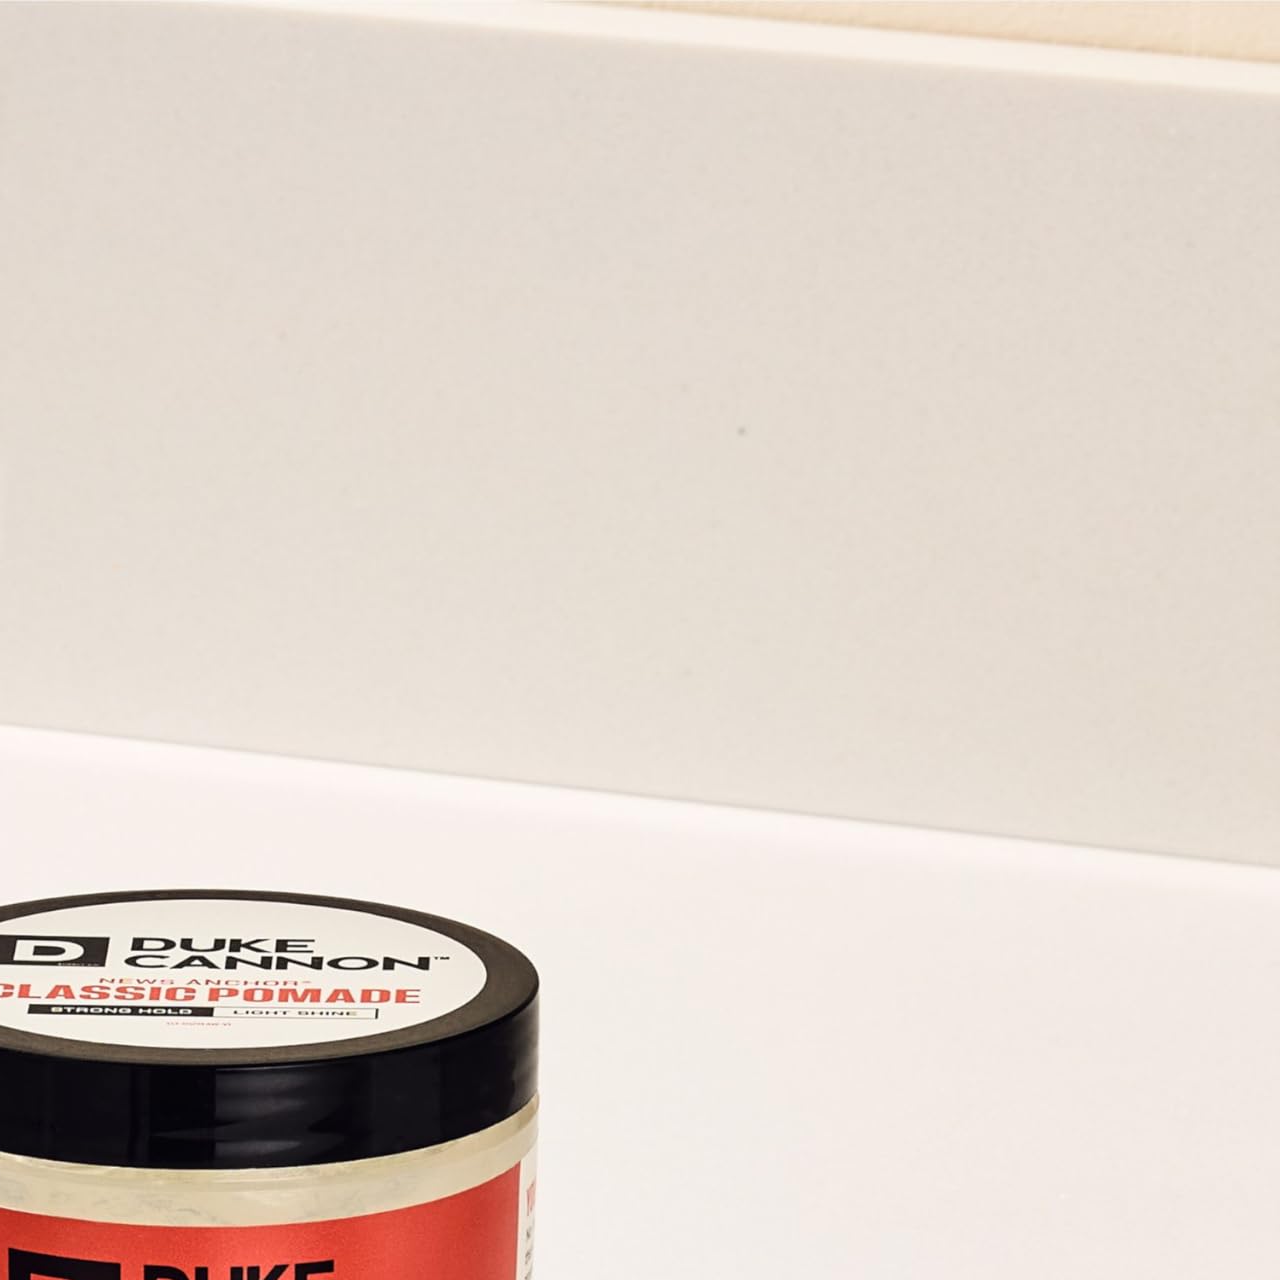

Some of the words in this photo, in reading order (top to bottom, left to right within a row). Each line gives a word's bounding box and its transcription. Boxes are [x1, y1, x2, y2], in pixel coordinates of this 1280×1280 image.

[13, 939, 84, 961] D
[131, 937, 316, 954] DUKE
[98, 977, 174, 986] NEWS
[207, 987, 421, 1004] POMADE
[50, 1006, 132, 1015] STRONG
[138, 1008, 193, 1016] HOLD
